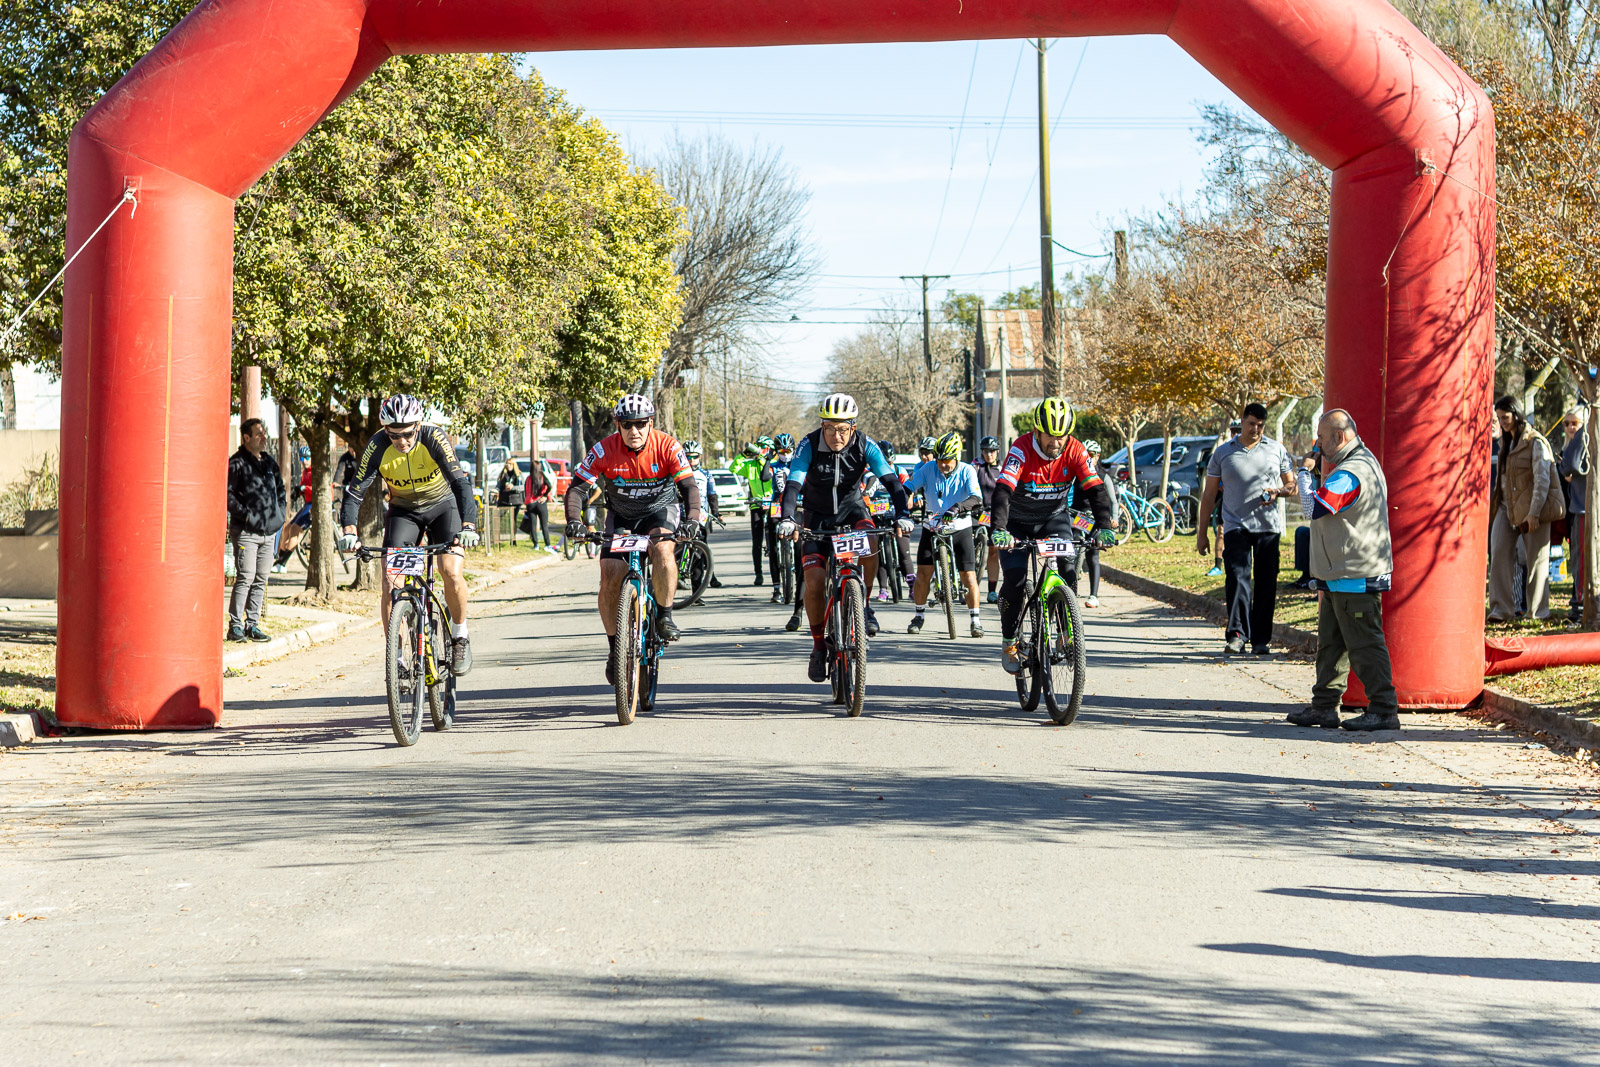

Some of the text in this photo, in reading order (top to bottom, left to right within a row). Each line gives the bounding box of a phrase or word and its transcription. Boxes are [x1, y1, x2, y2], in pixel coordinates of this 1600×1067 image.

[433, 428, 457, 463] MAXIBIKE
[355, 440, 378, 481] MAXIBIKE
[836, 537, 865, 553] 213
[1045, 543, 1067, 552] 30
[392, 555, 418, 569] 65
